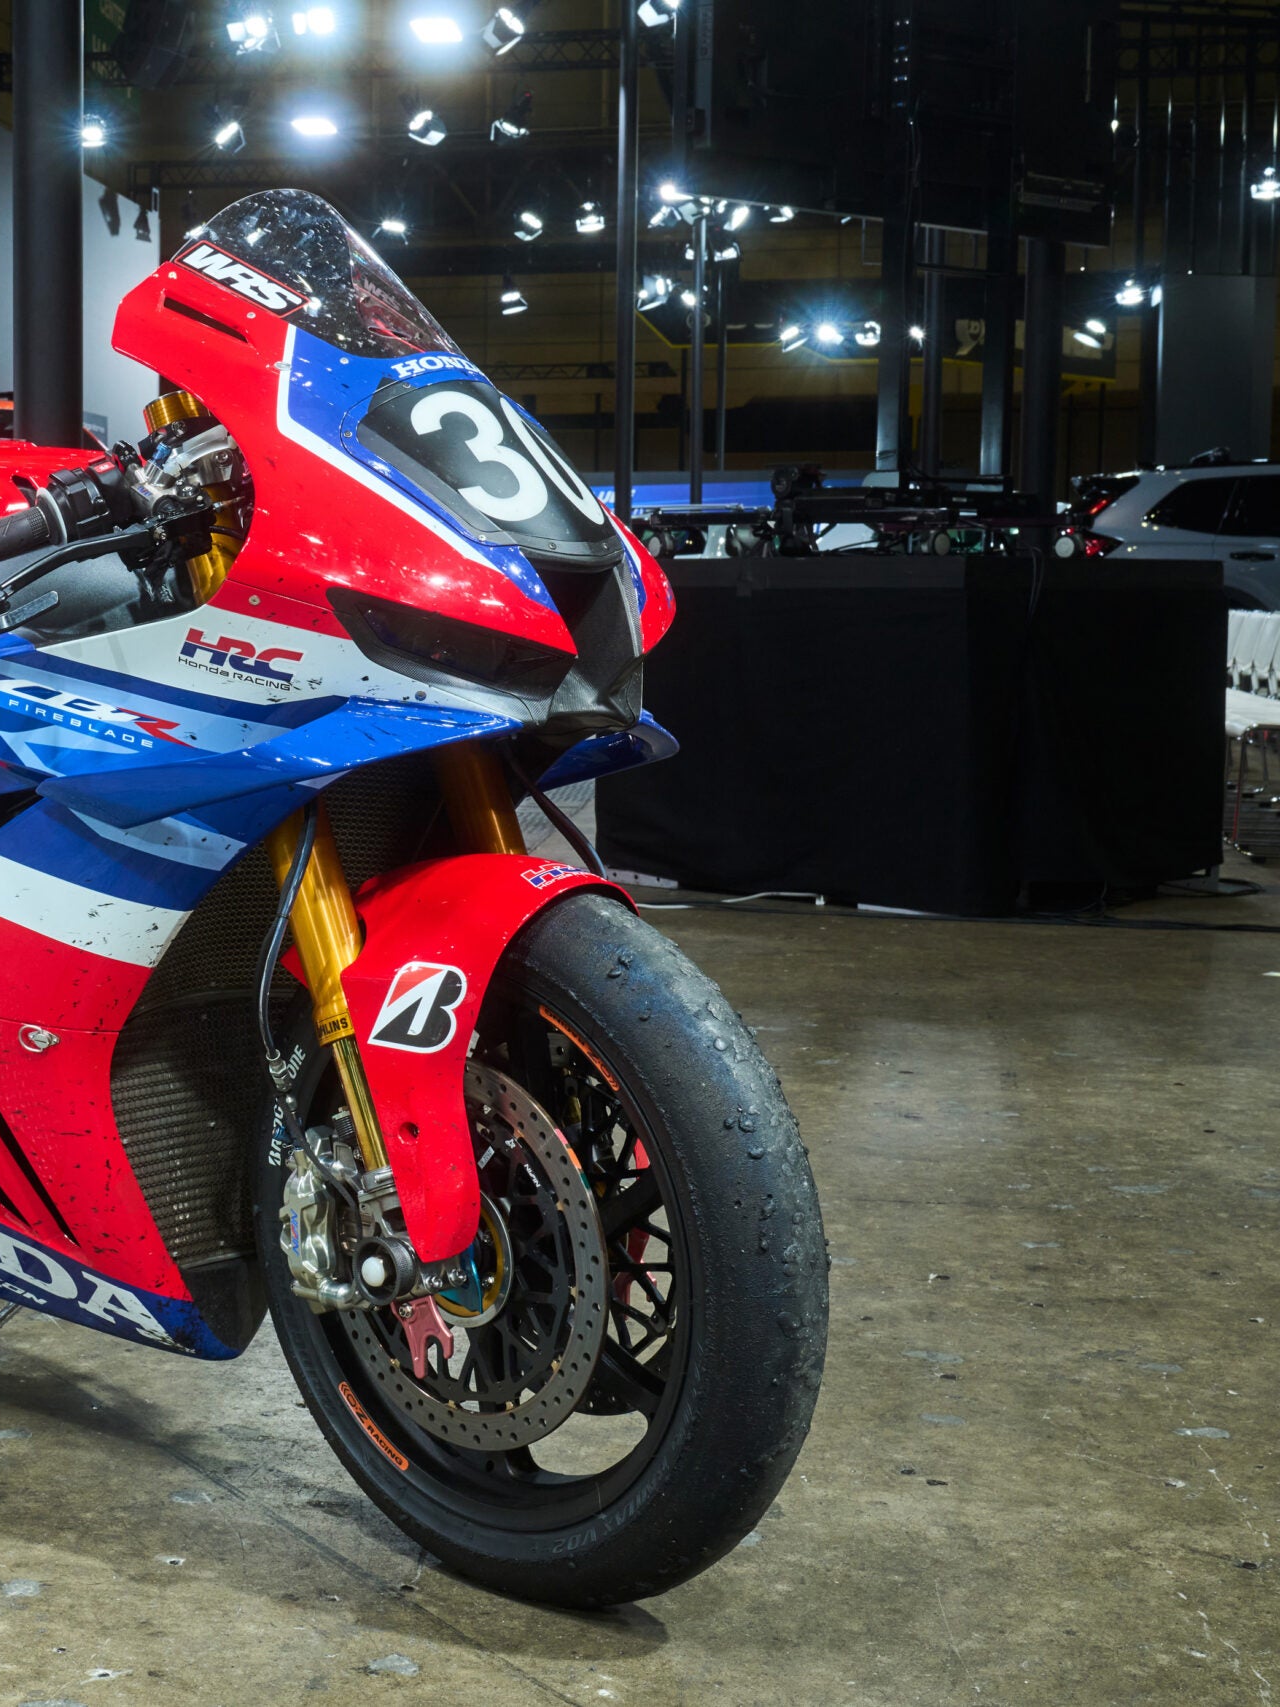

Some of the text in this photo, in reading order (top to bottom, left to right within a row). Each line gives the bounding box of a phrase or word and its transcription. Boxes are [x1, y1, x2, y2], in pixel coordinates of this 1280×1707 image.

[182, 244, 303, 310] WRS
[391, 355, 482, 379] HOND
[410, 390, 605, 525] 30
[178, 655, 292, 691] Honda RACING
[180, 627, 304, 683] HRC
[8, 698, 155, 739] FIREBLADE
[367, 1425, 403, 1466] RACING
